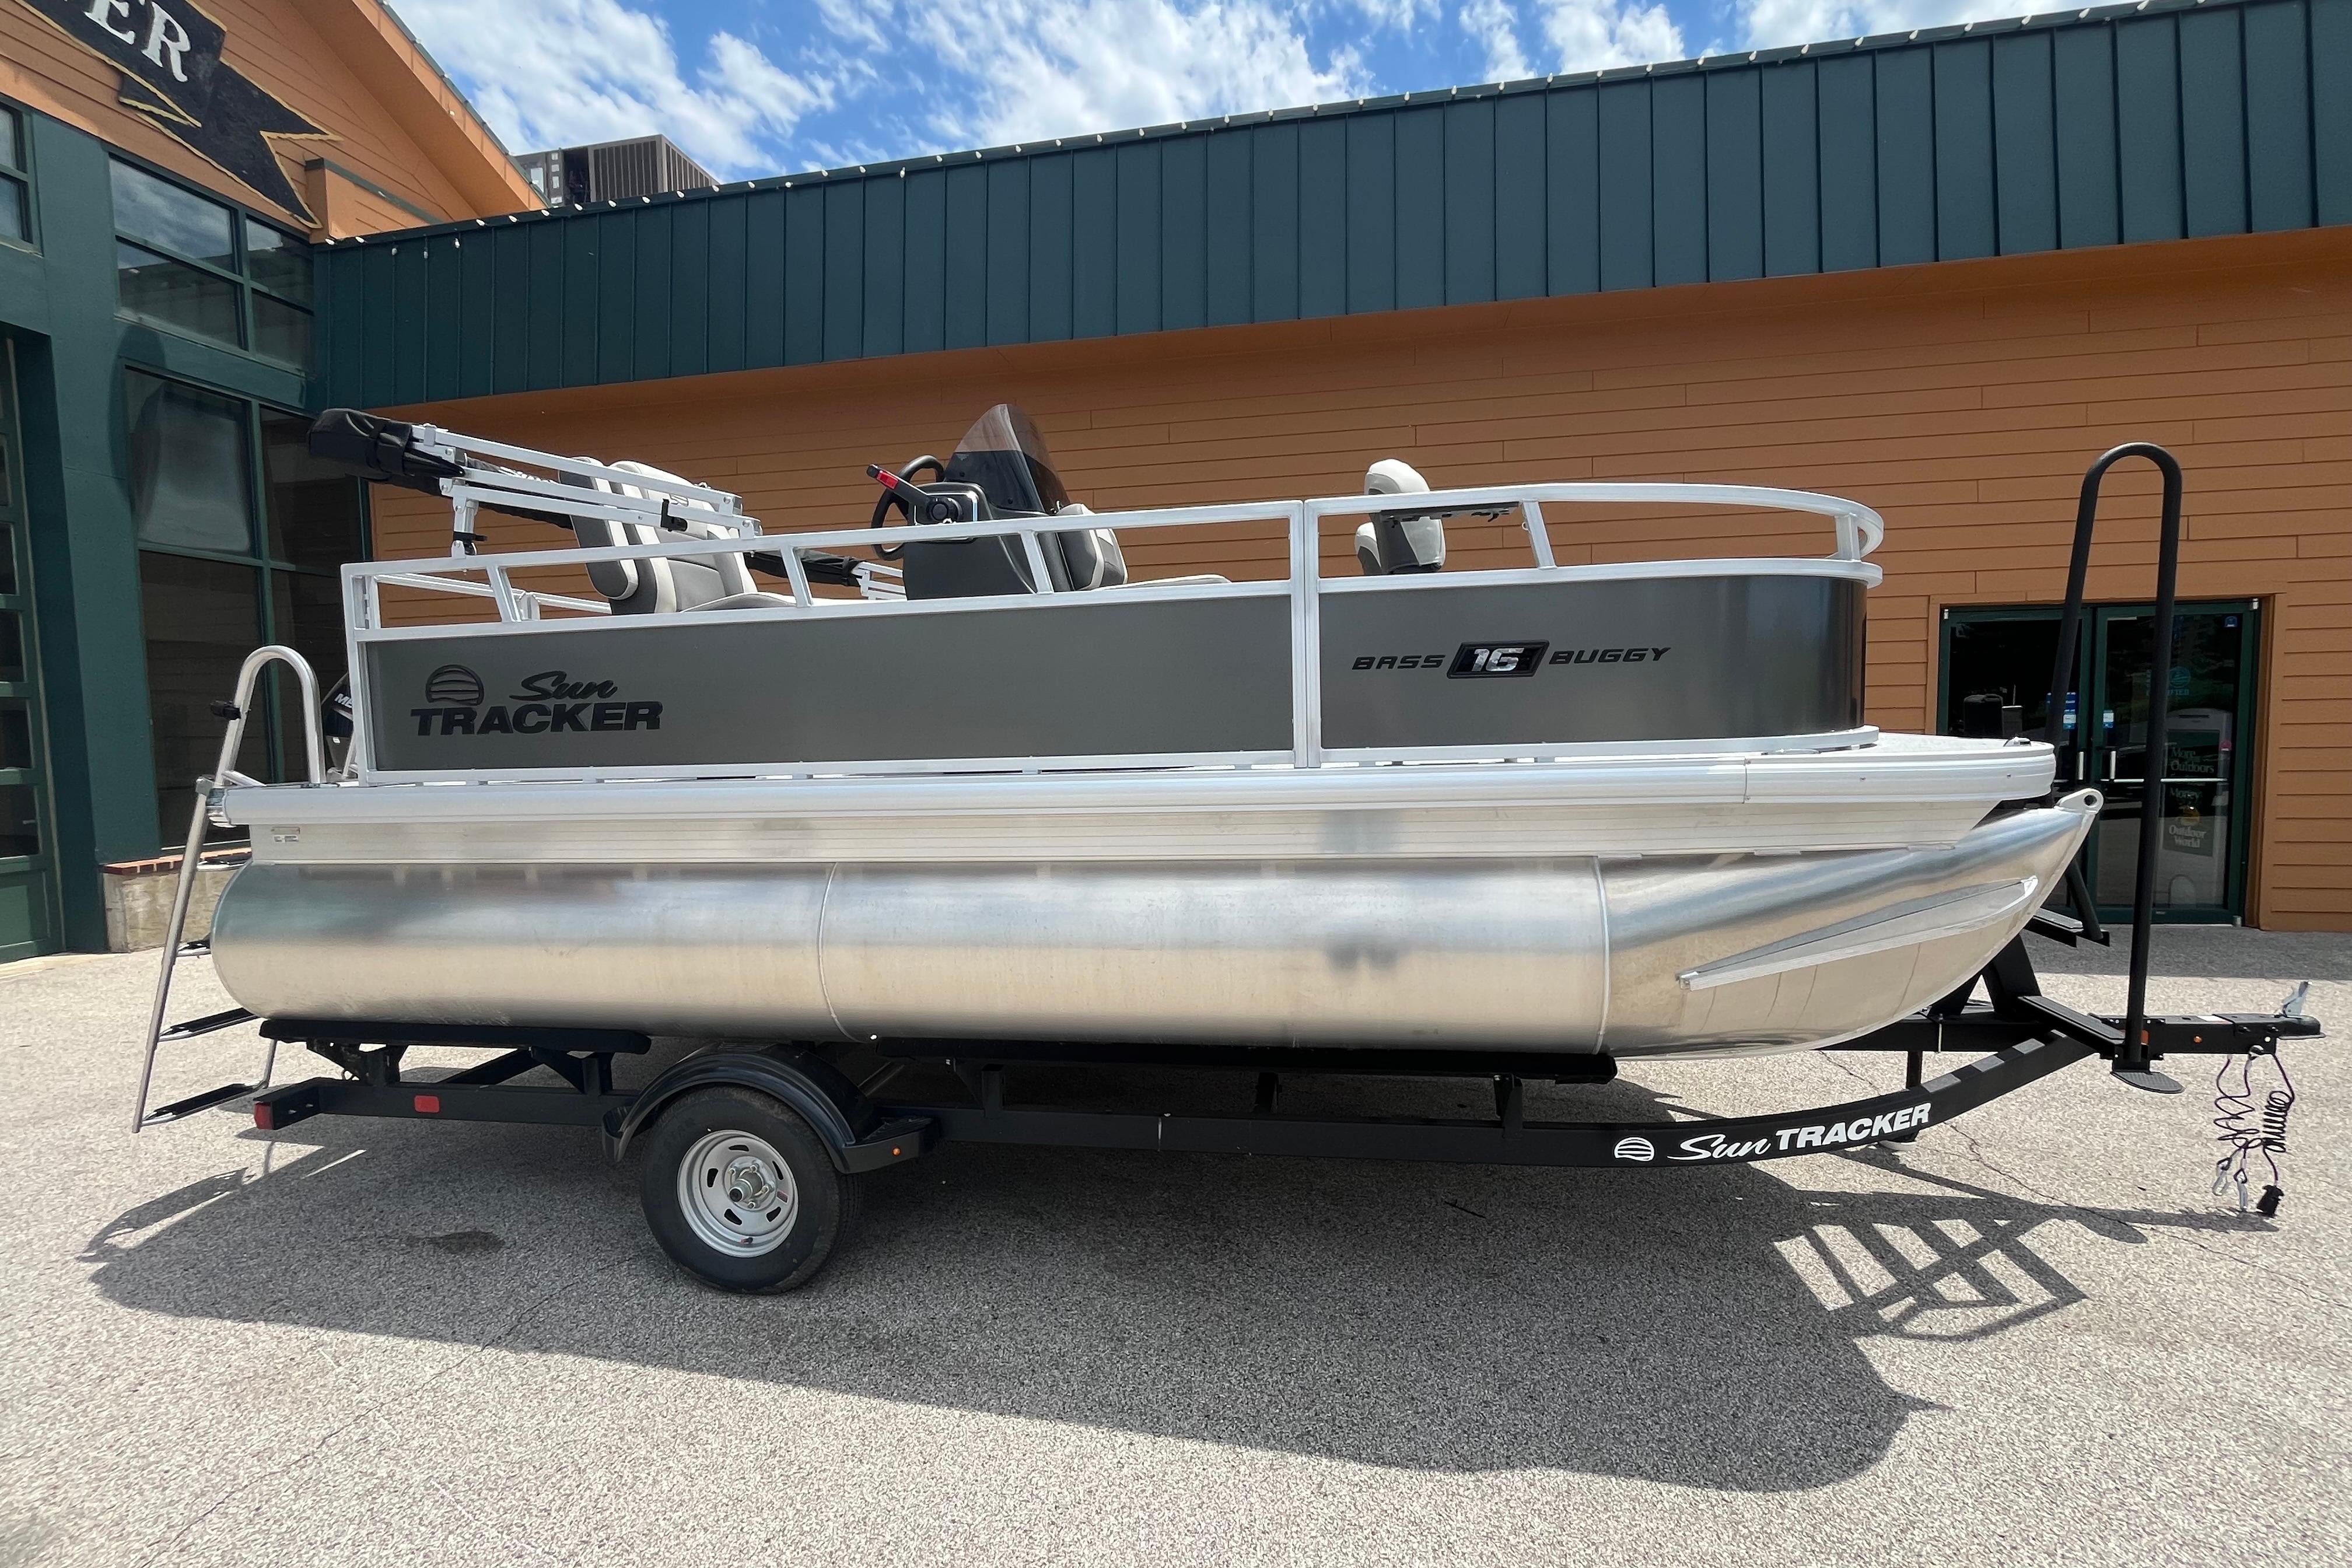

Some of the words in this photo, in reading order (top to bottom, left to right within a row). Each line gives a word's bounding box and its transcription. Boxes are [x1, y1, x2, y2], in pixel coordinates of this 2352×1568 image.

[1351, 654, 1446, 671] BASS
[1471, 647, 1525, 672] 16
[1549, 646, 1672, 666] BUGGY
[509, 670, 618, 701] Sun
[410, 701, 664, 736] TRACKER
[2170, 760, 2214, 774] Outdoors
[2169, 824, 2207, 839] Outdoor
[2174, 834, 2201, 848] World
[1667, 1133, 1772, 1161] Sun
[1775, 1102, 1932, 1151] TRACKER
